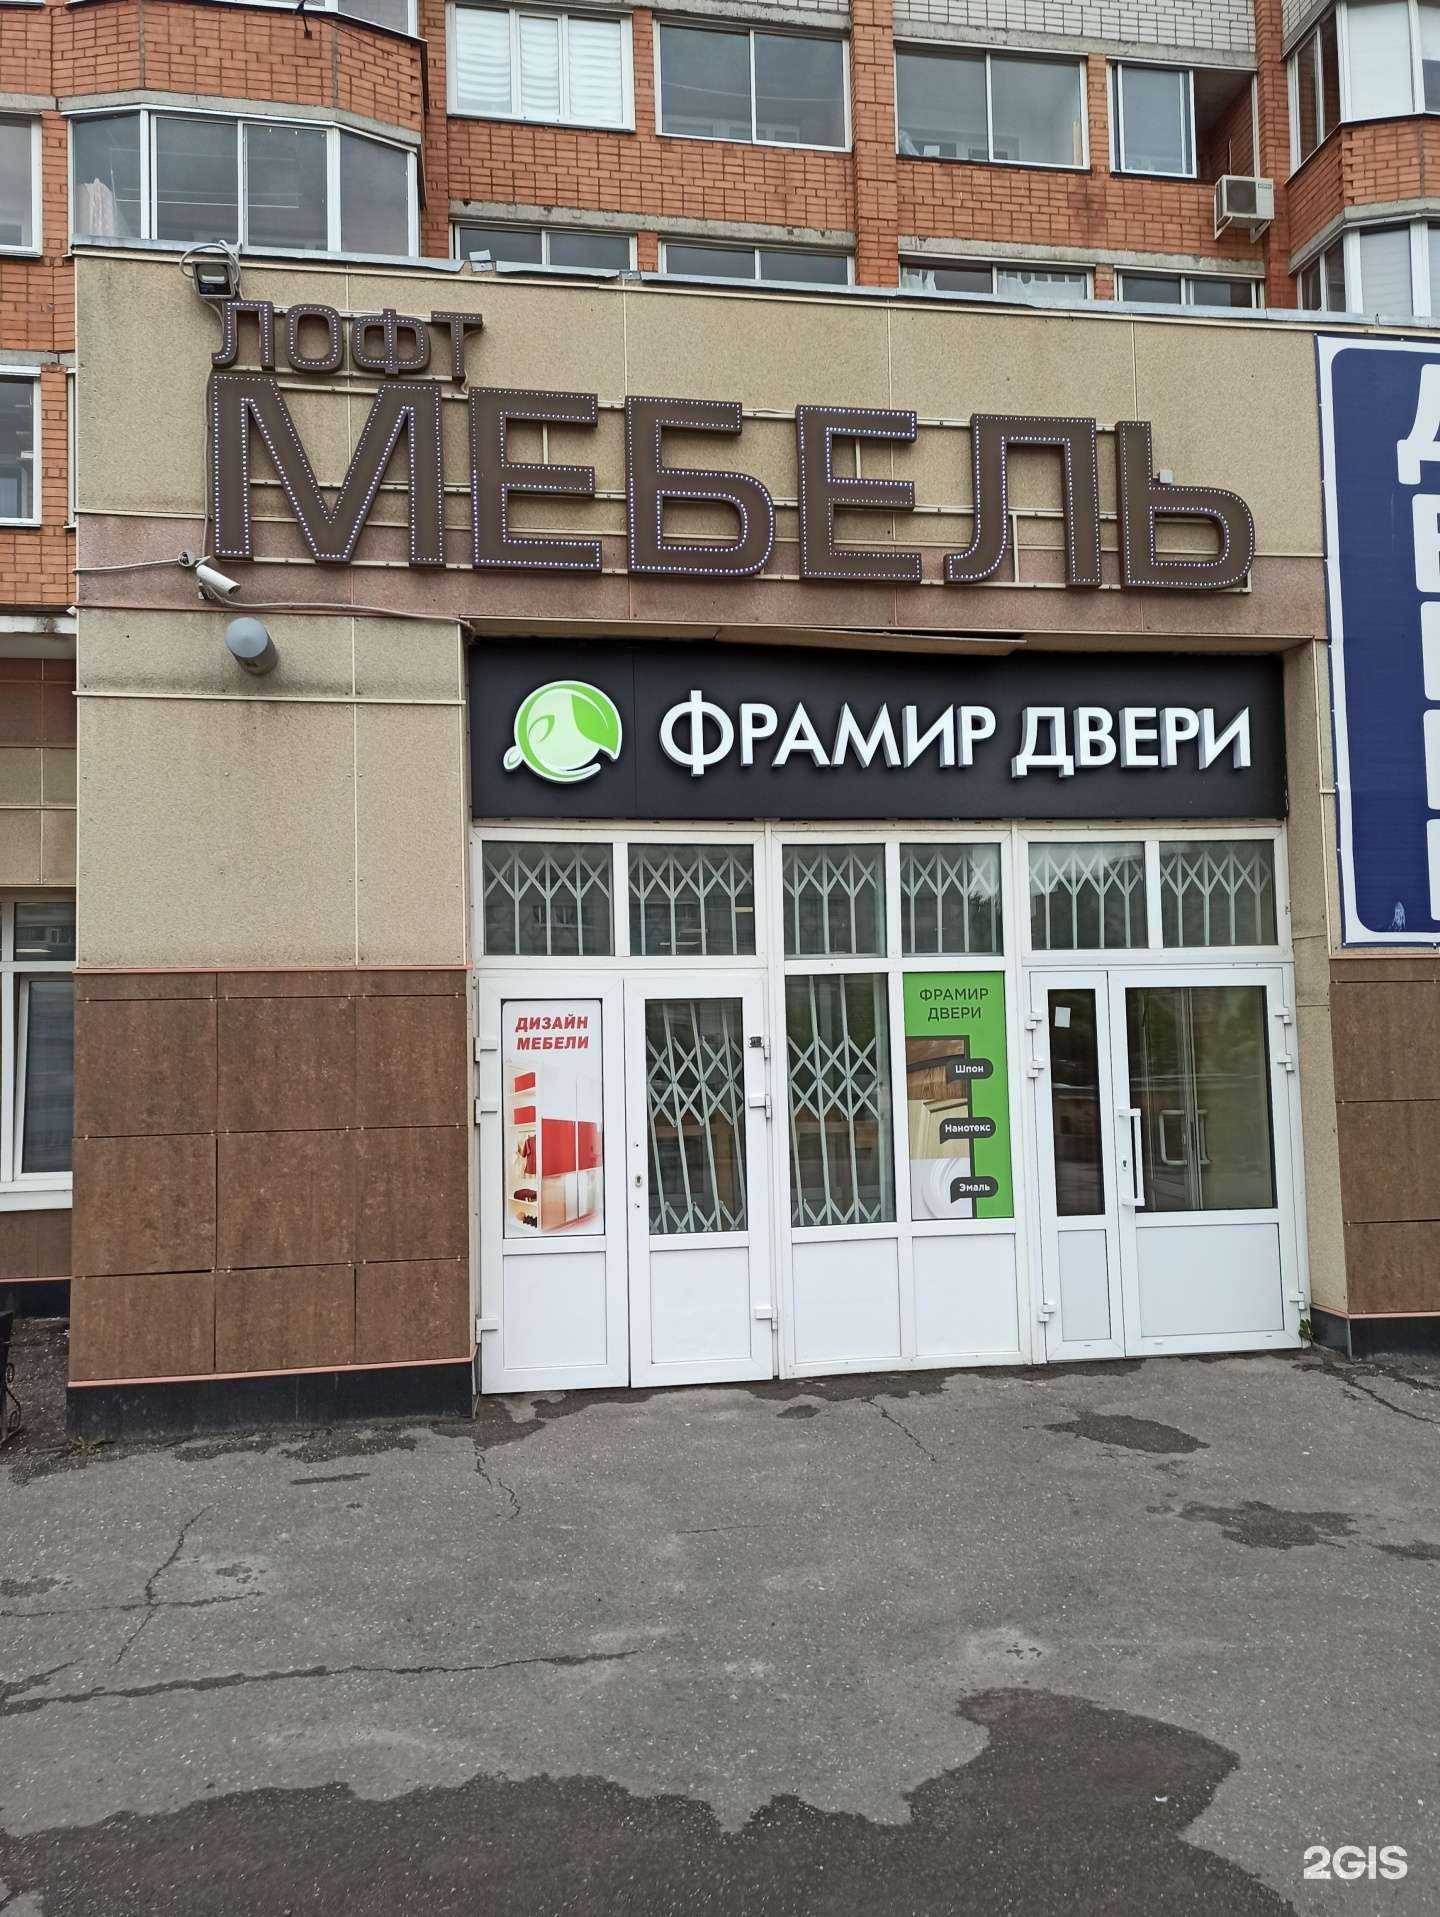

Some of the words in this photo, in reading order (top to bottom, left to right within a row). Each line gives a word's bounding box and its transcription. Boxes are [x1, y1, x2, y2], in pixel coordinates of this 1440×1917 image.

[211, 299, 483, 378] ЛОФТ
[207, 373, 1256, 592] МЕБЕЛЬ
[658, 689, 997, 777] ФРАМИР
[1011, 705, 1251, 779] ДВЕРИ
[919, 987, 990, 1002] ФРАМИР
[927, 1007, 982, 1022] ДВЕРИ
[515, 1012, 589, 1033] ДИЗАЙН
[516, 1036, 589, 1050] МЕБЕЛИ
[954, 1063, 984, 1074] Шпон
[944, 1123, 991, 1134] Нанотекс
[959, 1182, 991, 1193] Эмаль
